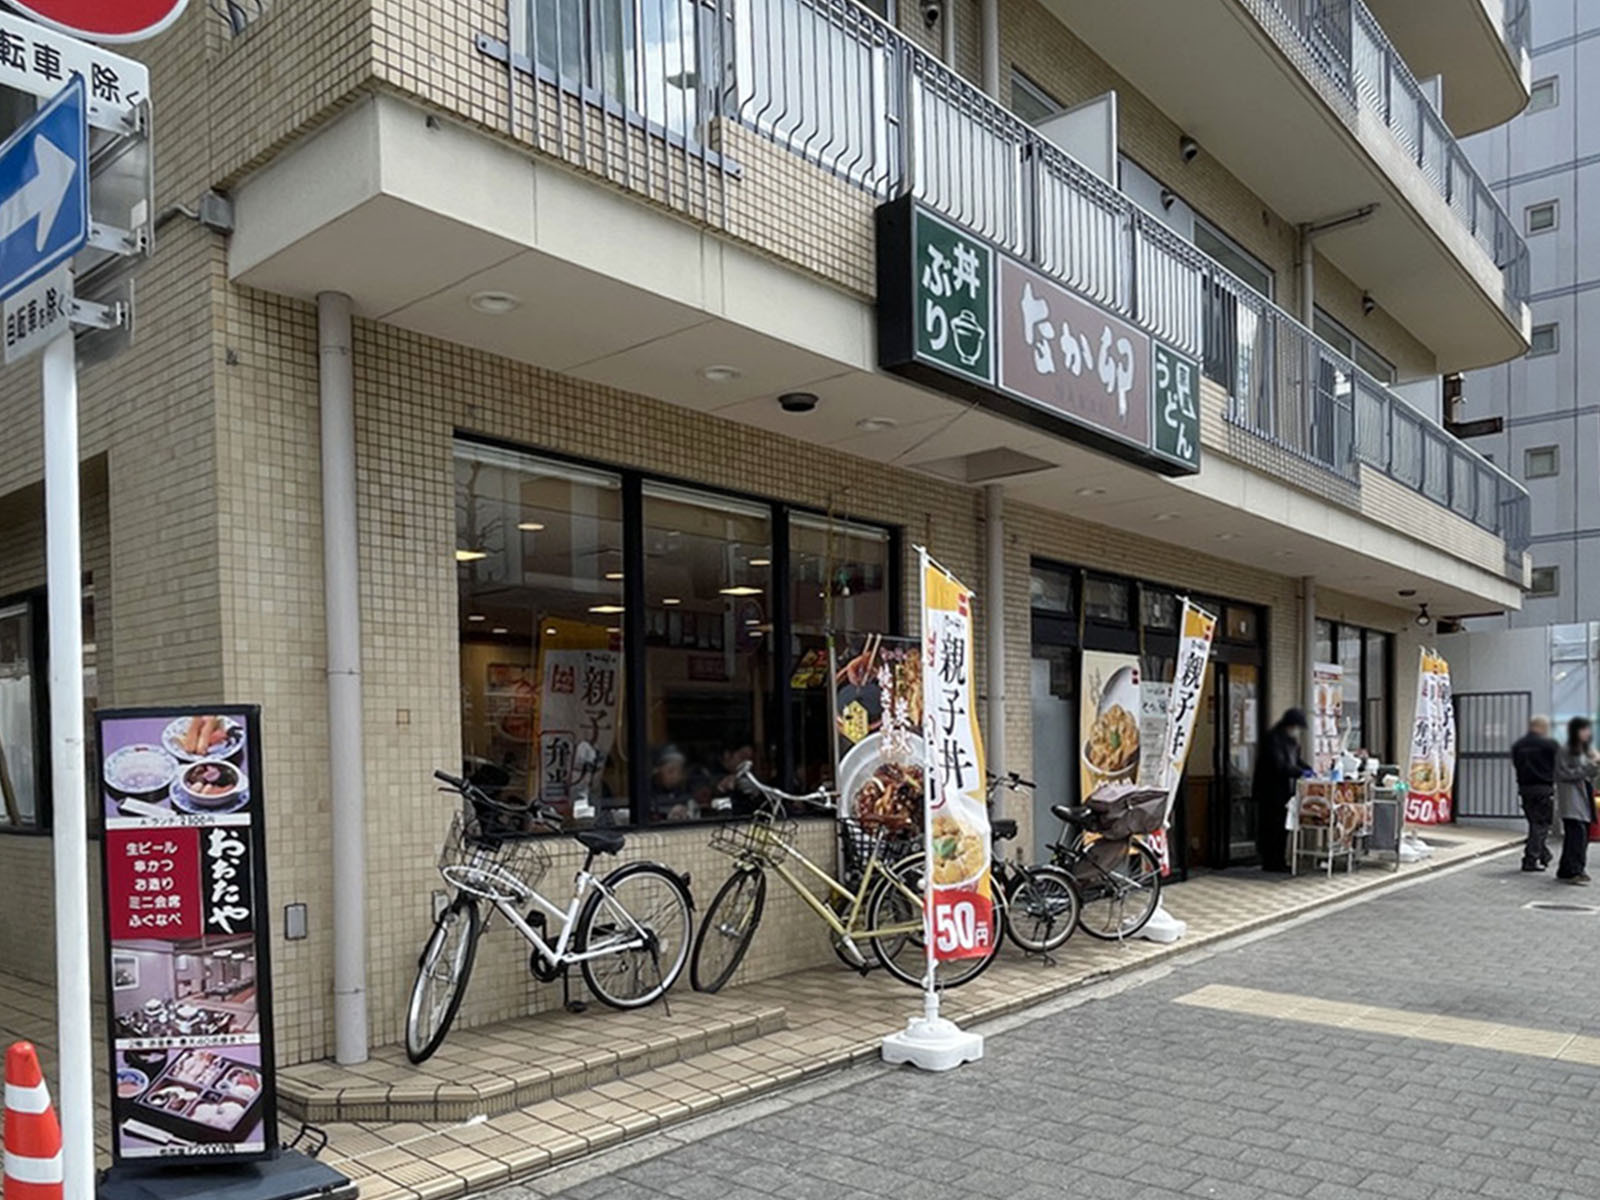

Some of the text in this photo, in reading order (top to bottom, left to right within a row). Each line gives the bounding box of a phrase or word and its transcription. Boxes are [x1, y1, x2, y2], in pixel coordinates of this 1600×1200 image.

[0, 28, 139, 107] 転車除く
[1021, 283, 1134, 417] なか卯
[1156, 351, 1193, 459] うどん
[938, 632, 974, 790] 親子丼
[126, 841, 178, 856] 生ビール
[207, 827, 250, 935] おおたや
[128, 913, 183, 928] ふぐなべ
[922, 900, 989, 953] 50円
